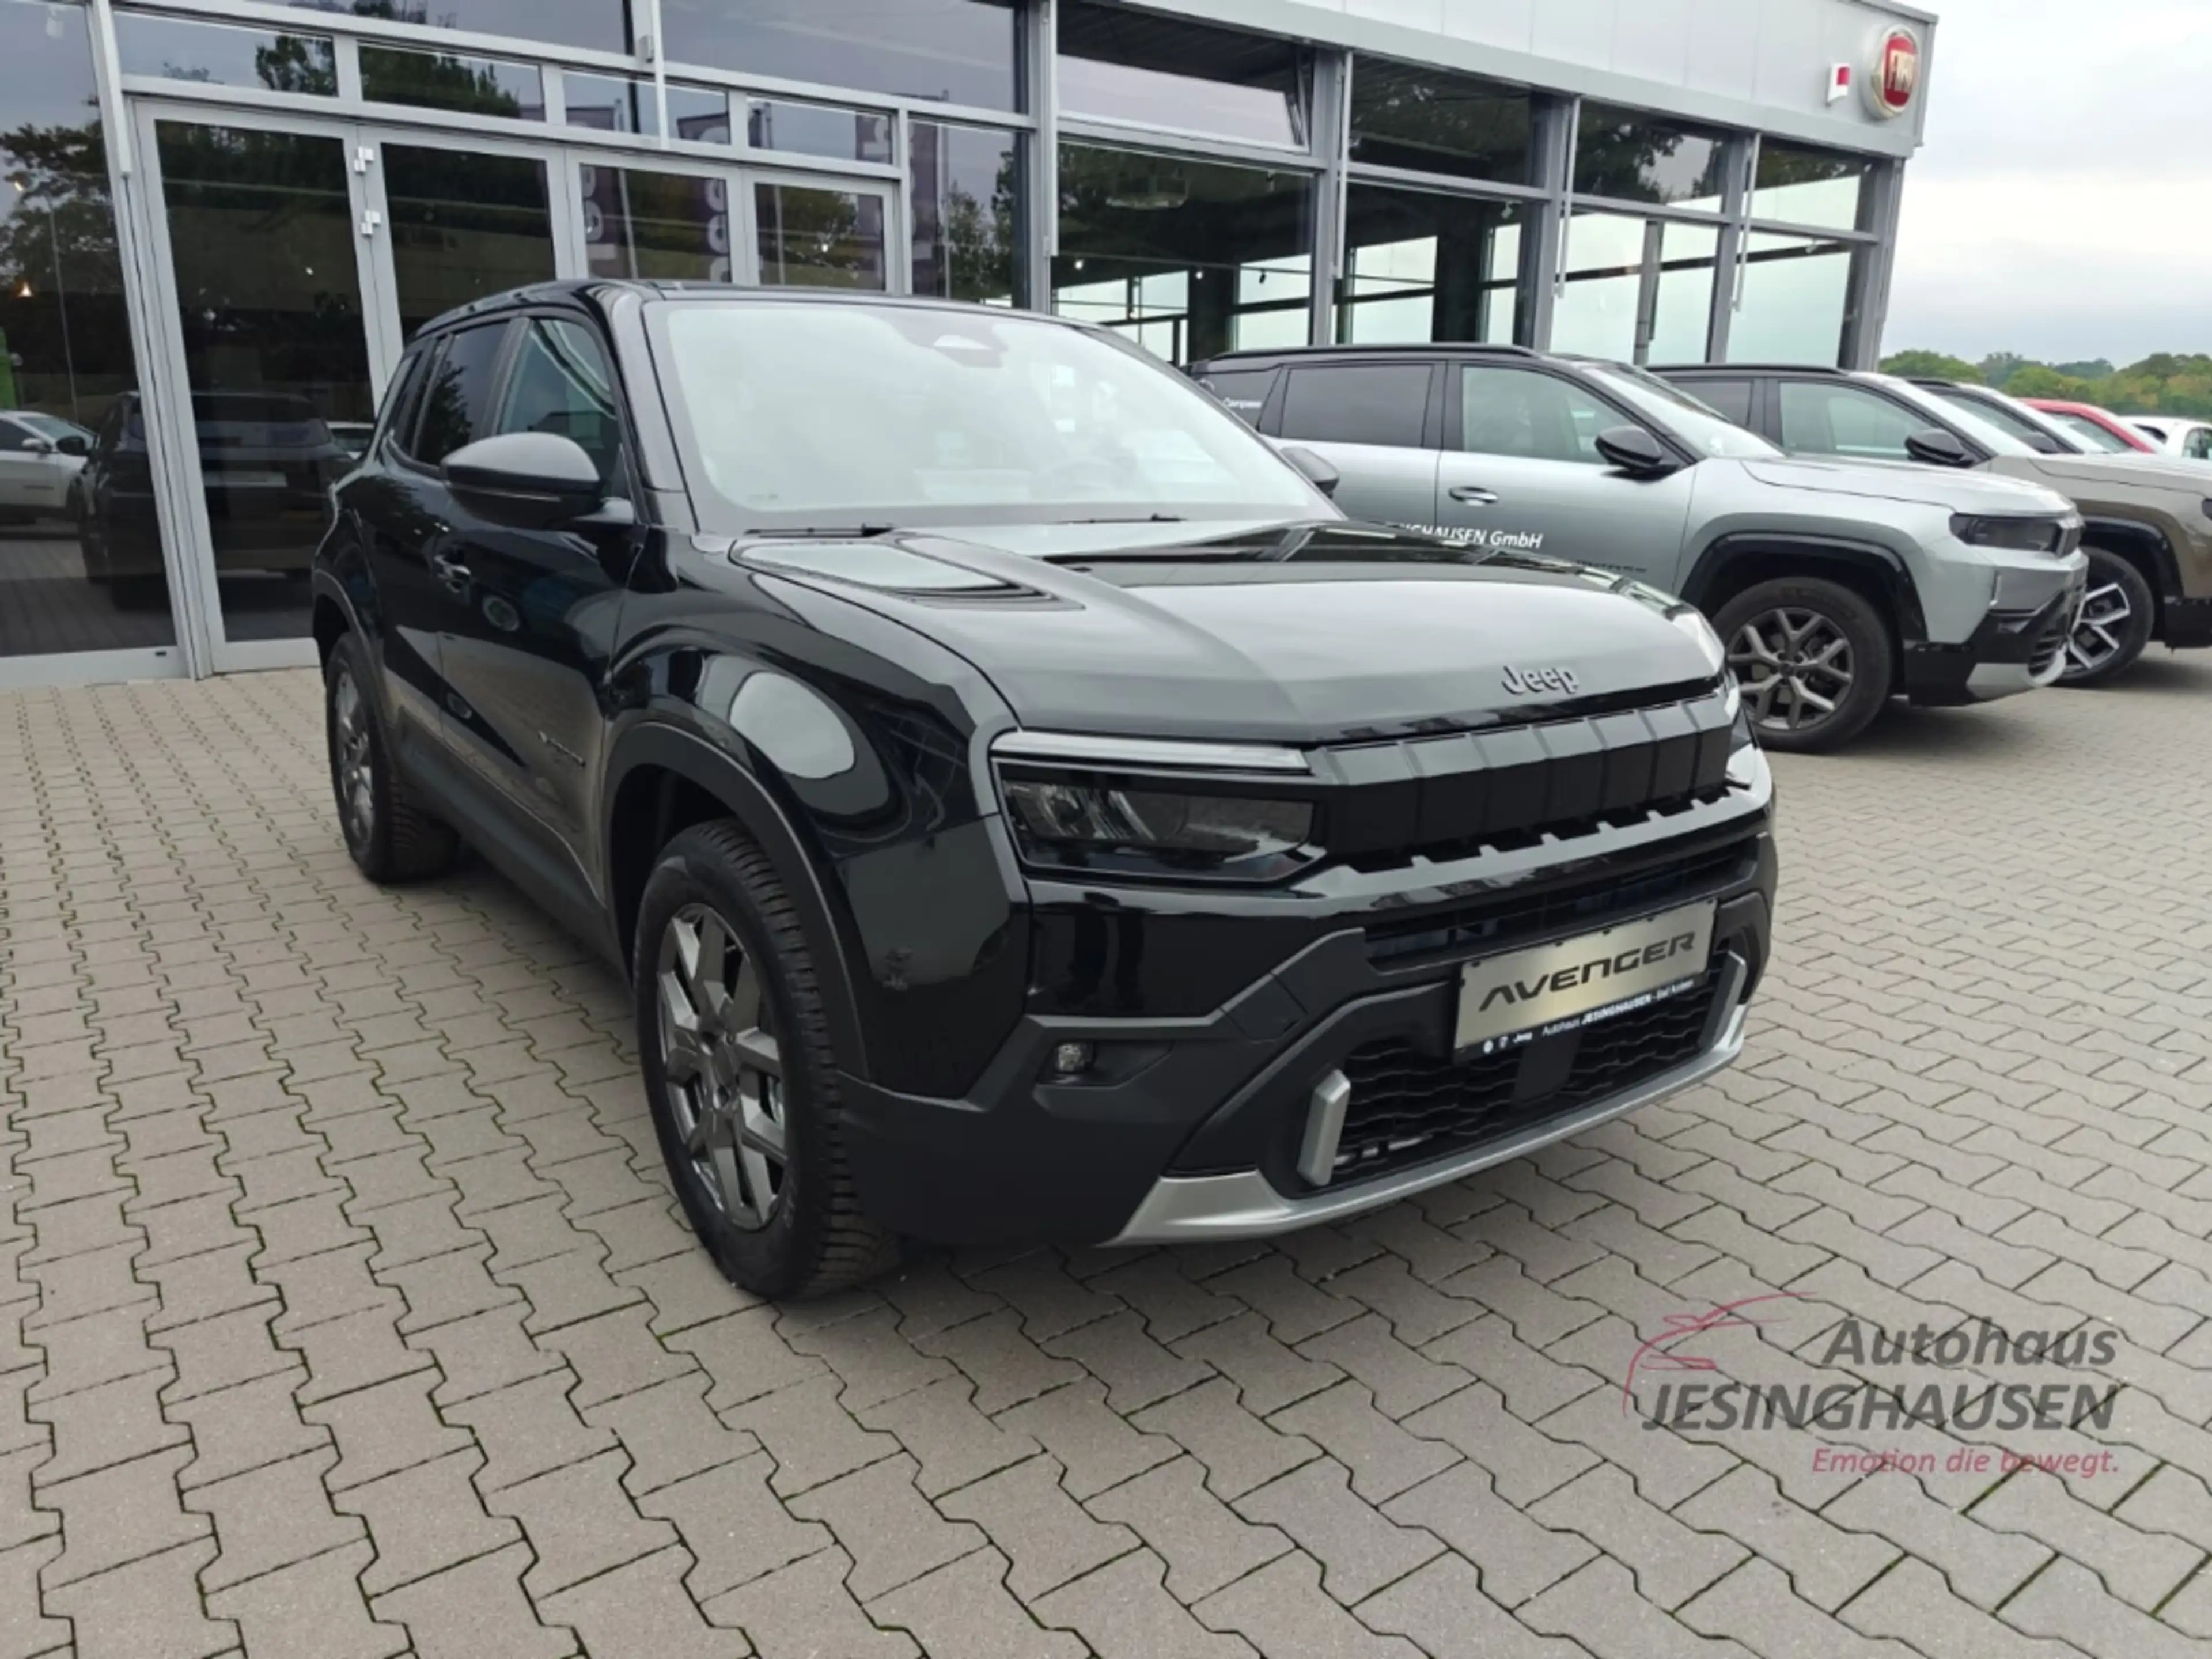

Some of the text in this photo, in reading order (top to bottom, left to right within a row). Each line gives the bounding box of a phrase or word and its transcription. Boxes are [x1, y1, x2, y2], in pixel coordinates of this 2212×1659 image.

[1490, 530, 1544, 549] GmbH
[1501, 665, 1581, 696] Jeep
[1479, 931, 1695, 1013] AVENGER
